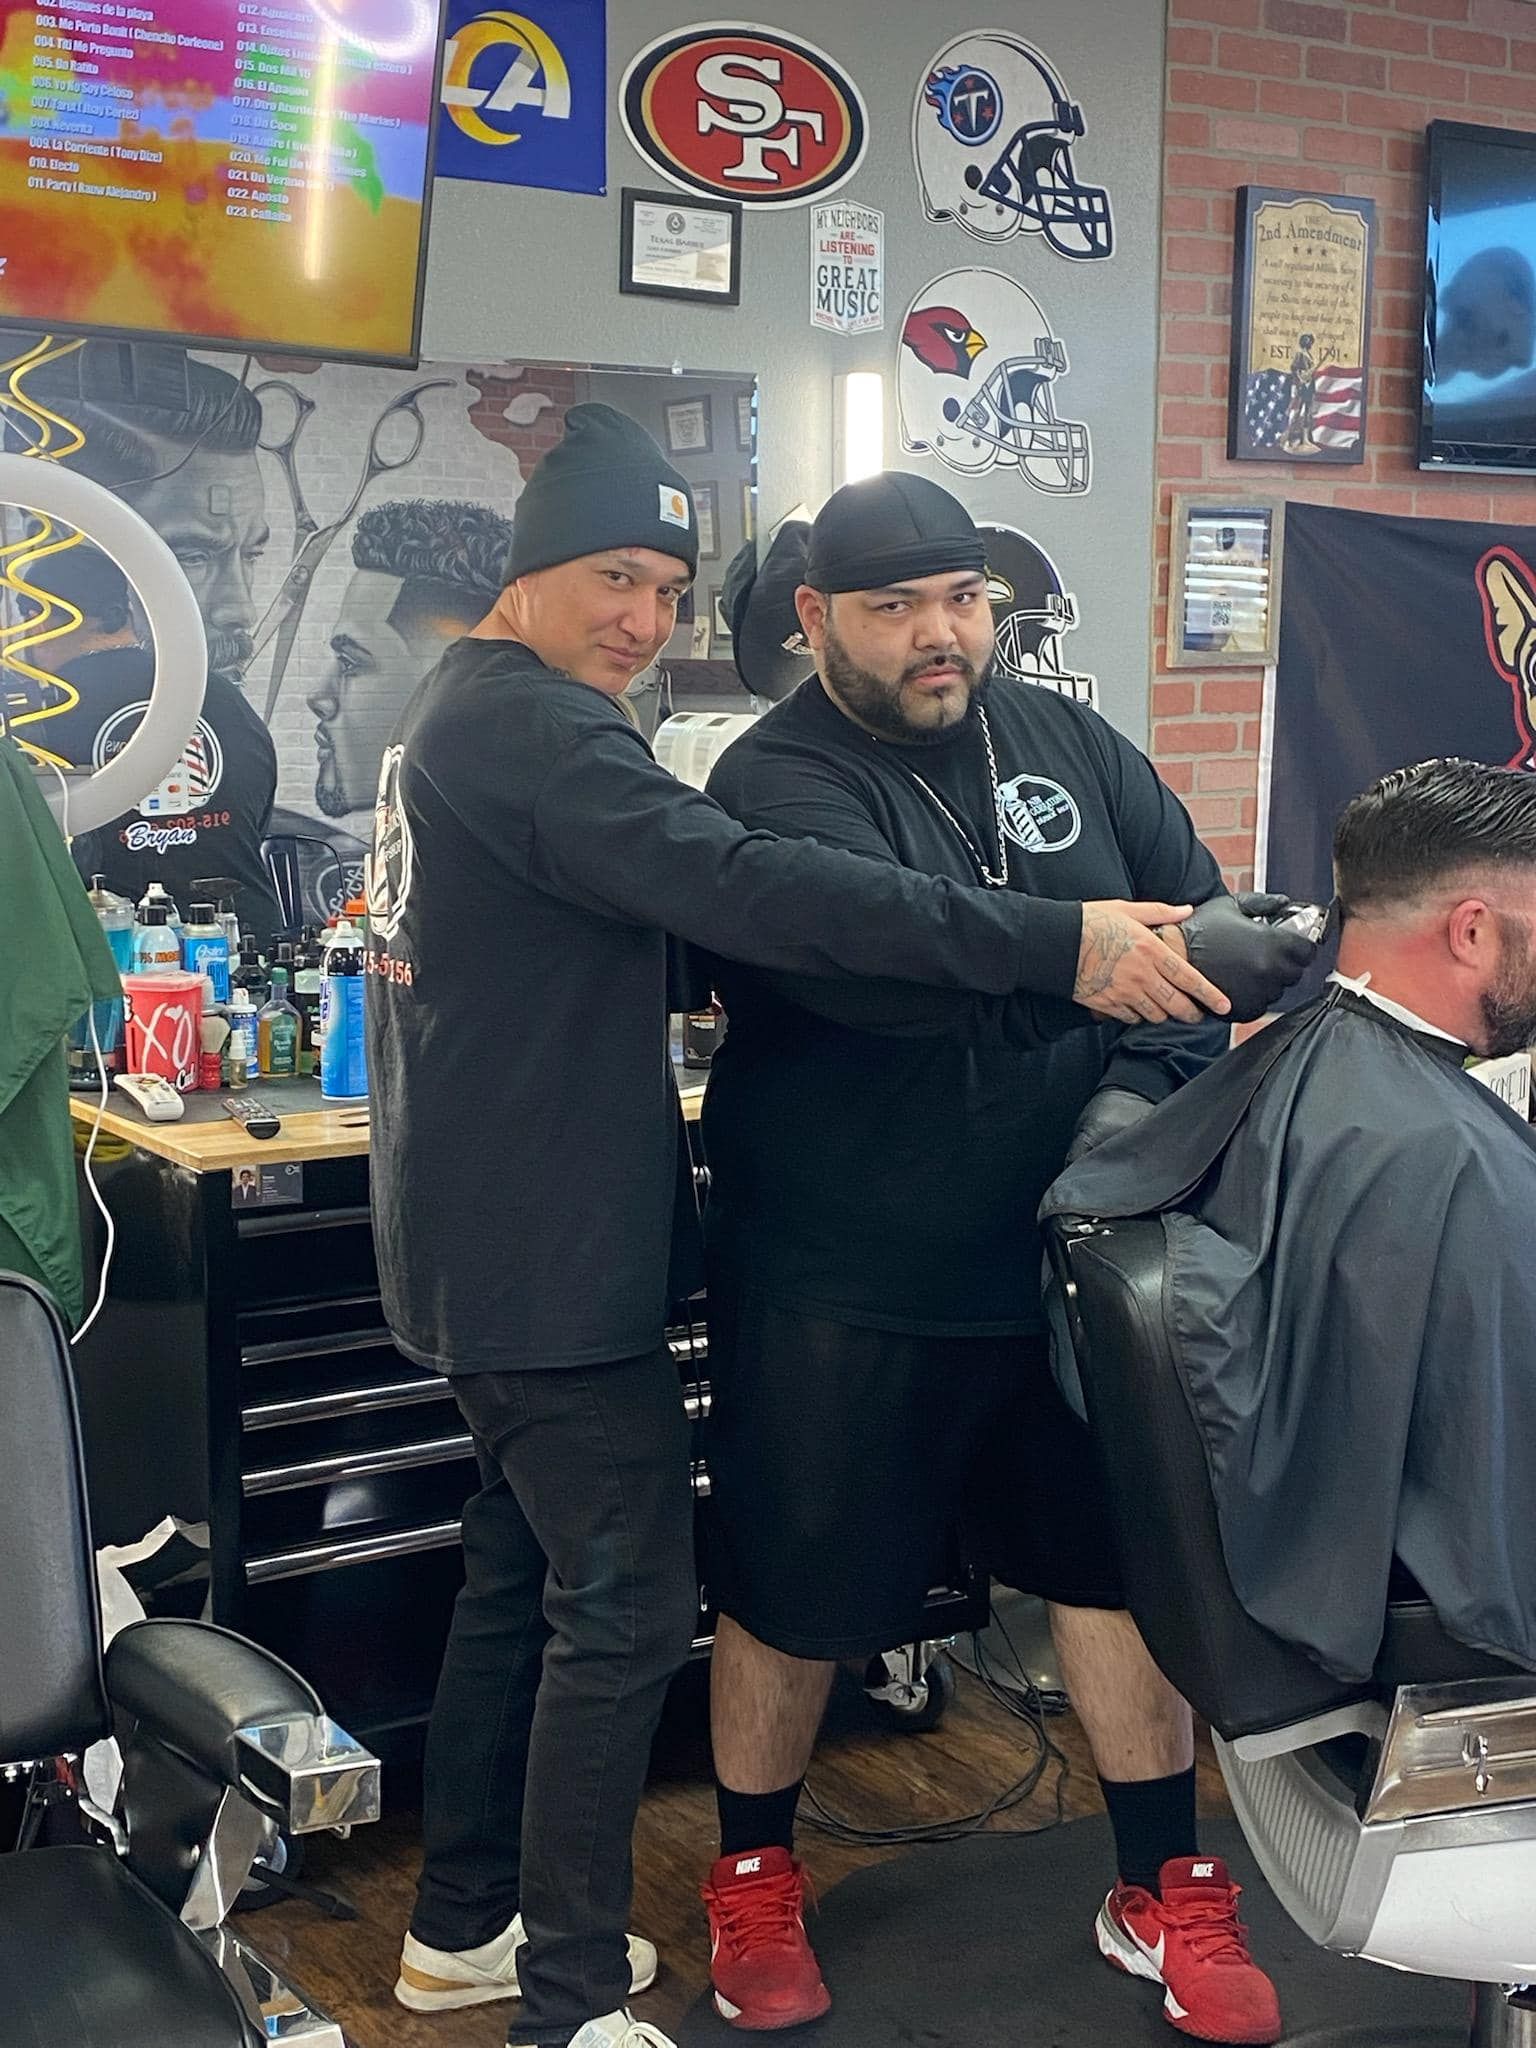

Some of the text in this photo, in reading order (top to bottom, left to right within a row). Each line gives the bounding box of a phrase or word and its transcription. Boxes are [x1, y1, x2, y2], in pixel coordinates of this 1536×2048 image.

[73, 40, 88, 52] Me
[52, 138, 62, 150] La
[816, 208, 879, 234] MY NEIGHBORS
[840, 231, 856, 240] ARE
[1260, 222, 1362, 251] 2nd Amendment
[820, 240, 875, 256] LISTENING
[843, 256, 852, 264] TO
[817, 265, 878, 290] GREAT
[817, 288, 879, 319] MUSIC
[126, 821, 198, 855] Bryan
[735, 1856, 762, 1876] NIKE
[1191, 1862, 1215, 1878] NIKE
